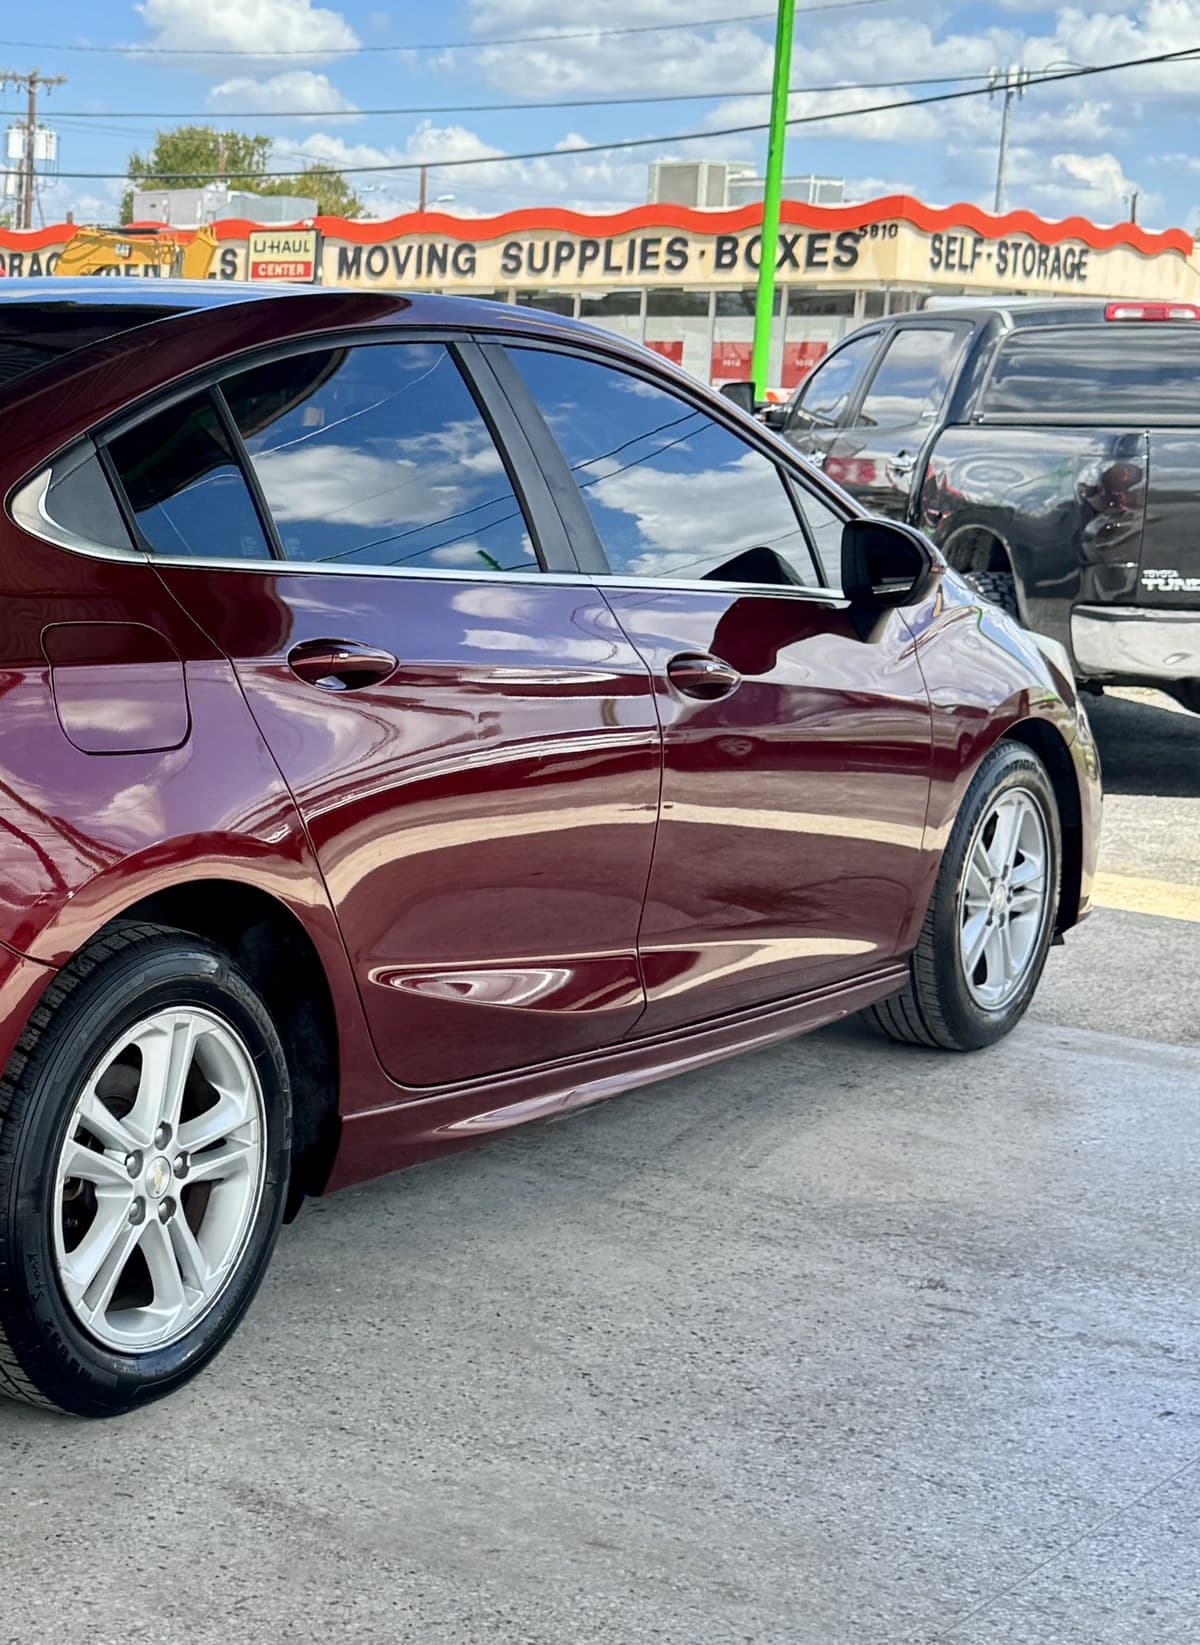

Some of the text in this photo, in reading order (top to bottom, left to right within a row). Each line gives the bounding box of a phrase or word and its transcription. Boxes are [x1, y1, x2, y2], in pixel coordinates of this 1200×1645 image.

[859, 223, 898, 240] 5810
[337, 231, 860, 281] MOVING SUPPLIES BOXES
[258, 262, 305, 277] CENTER
